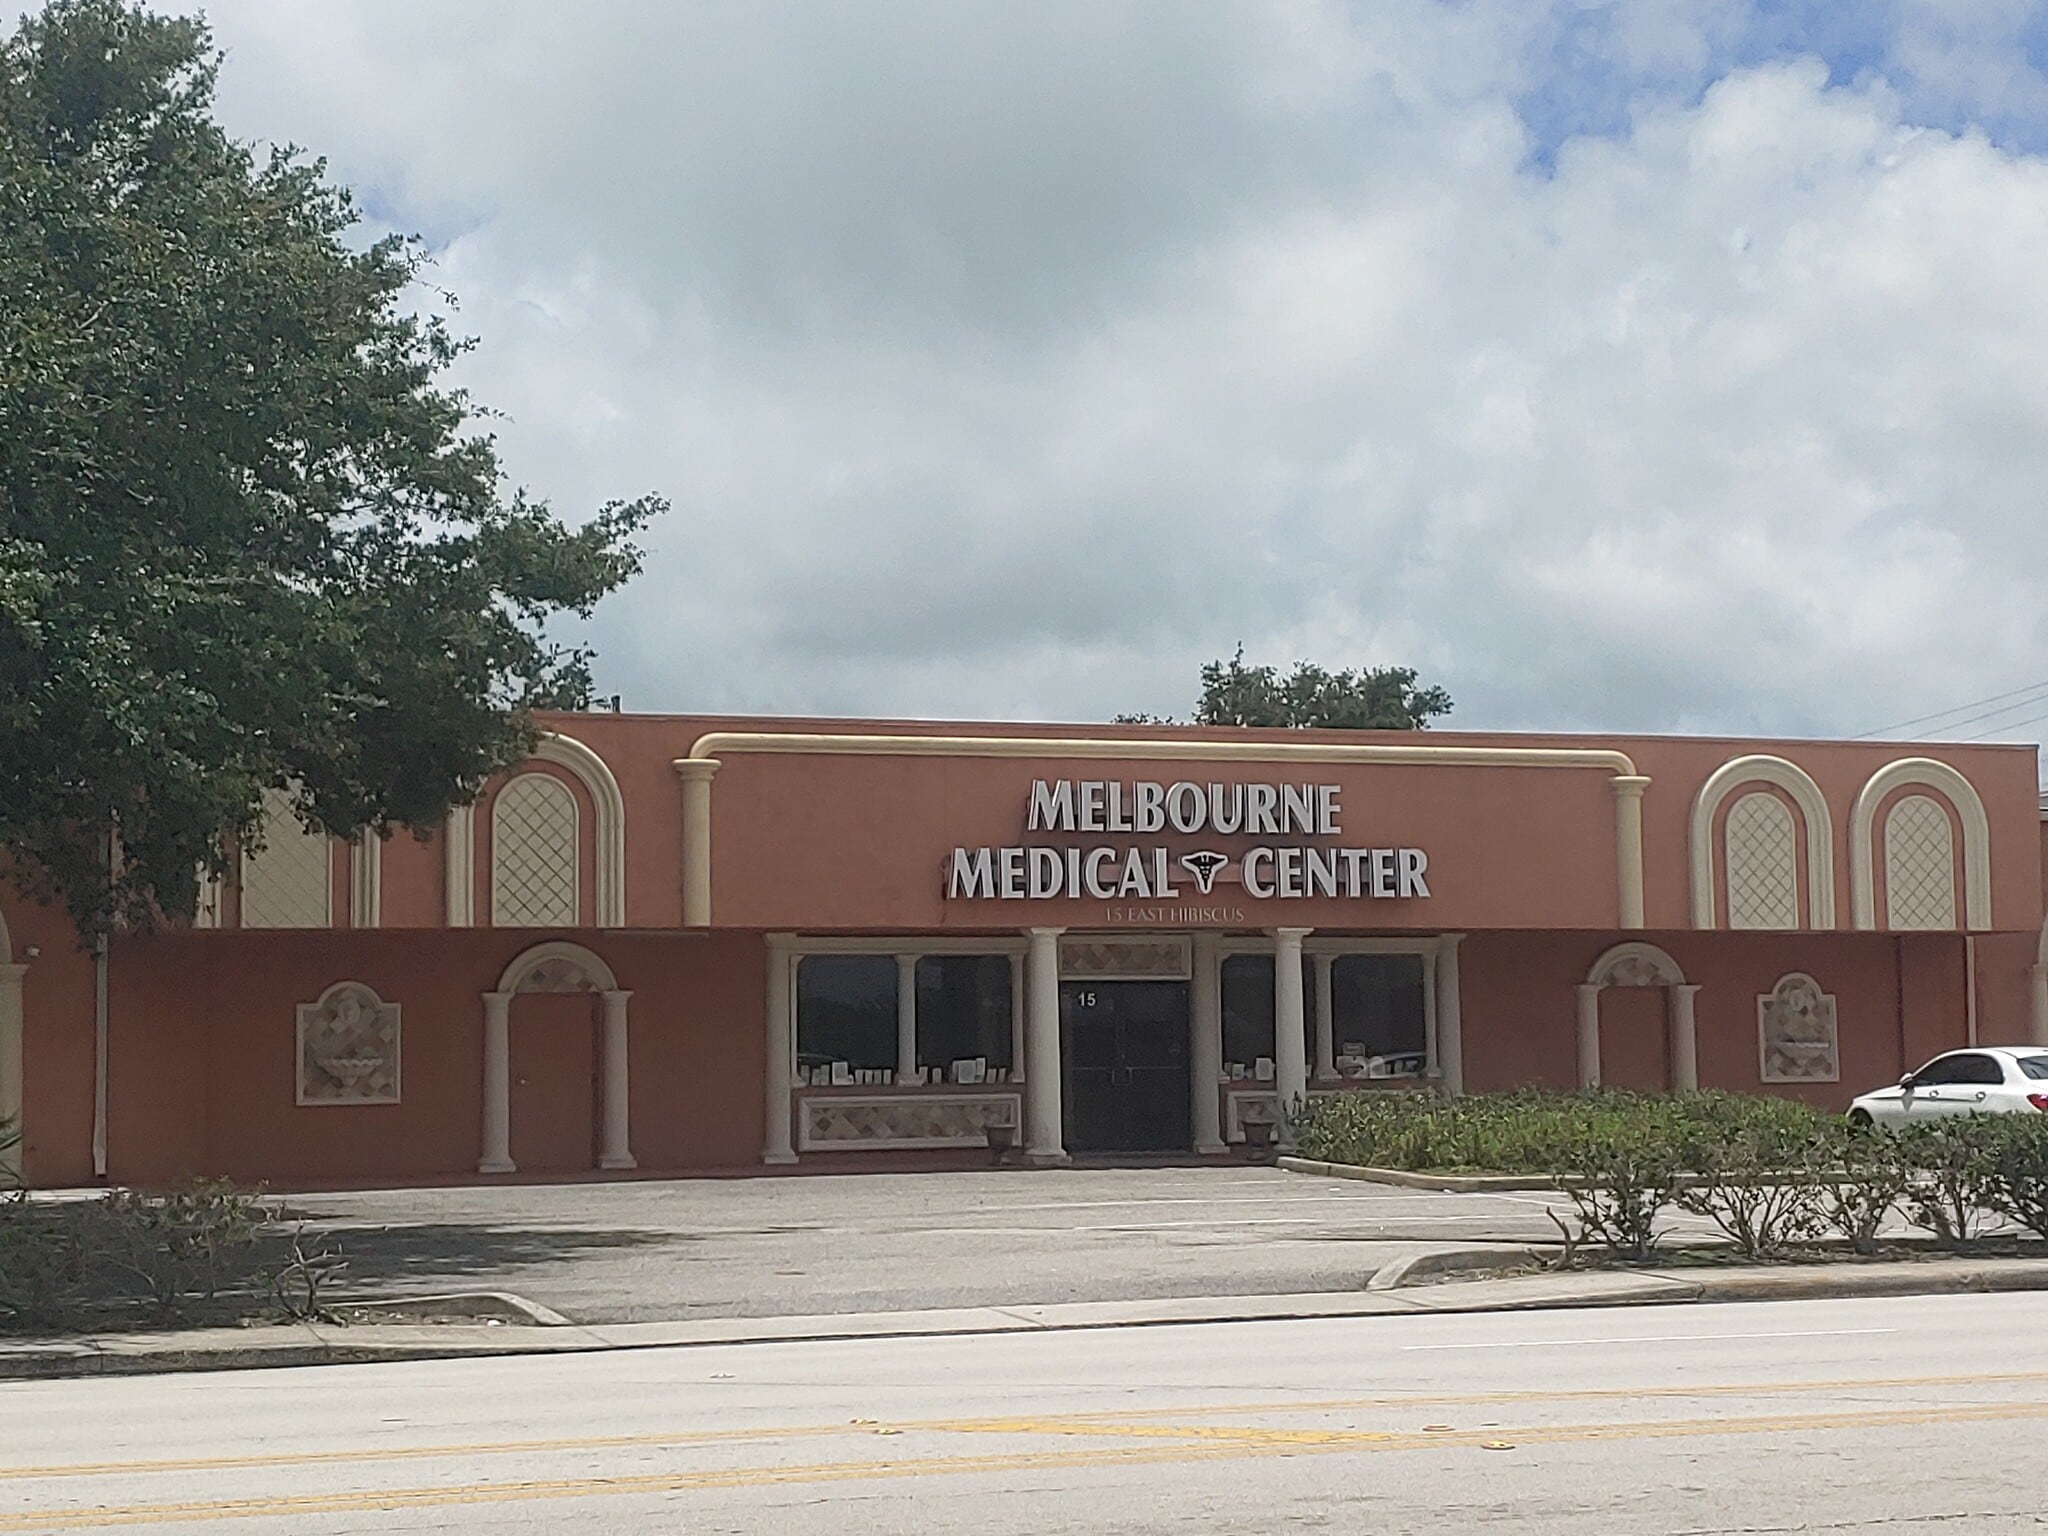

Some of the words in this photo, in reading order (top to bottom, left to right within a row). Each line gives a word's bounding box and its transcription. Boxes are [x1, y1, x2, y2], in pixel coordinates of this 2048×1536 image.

[1027, 778, 1343, 834] MELBOURNE
[948, 847, 1179, 899] MEDICAL
[1241, 847, 1432, 900] CENTER
[1106, 907, 1122, 922] 15
[1128, 907, 1165, 922] EAST
[1171, 907, 1245, 923] HIBISCUS
[1078, 992, 1096, 1007] 15
